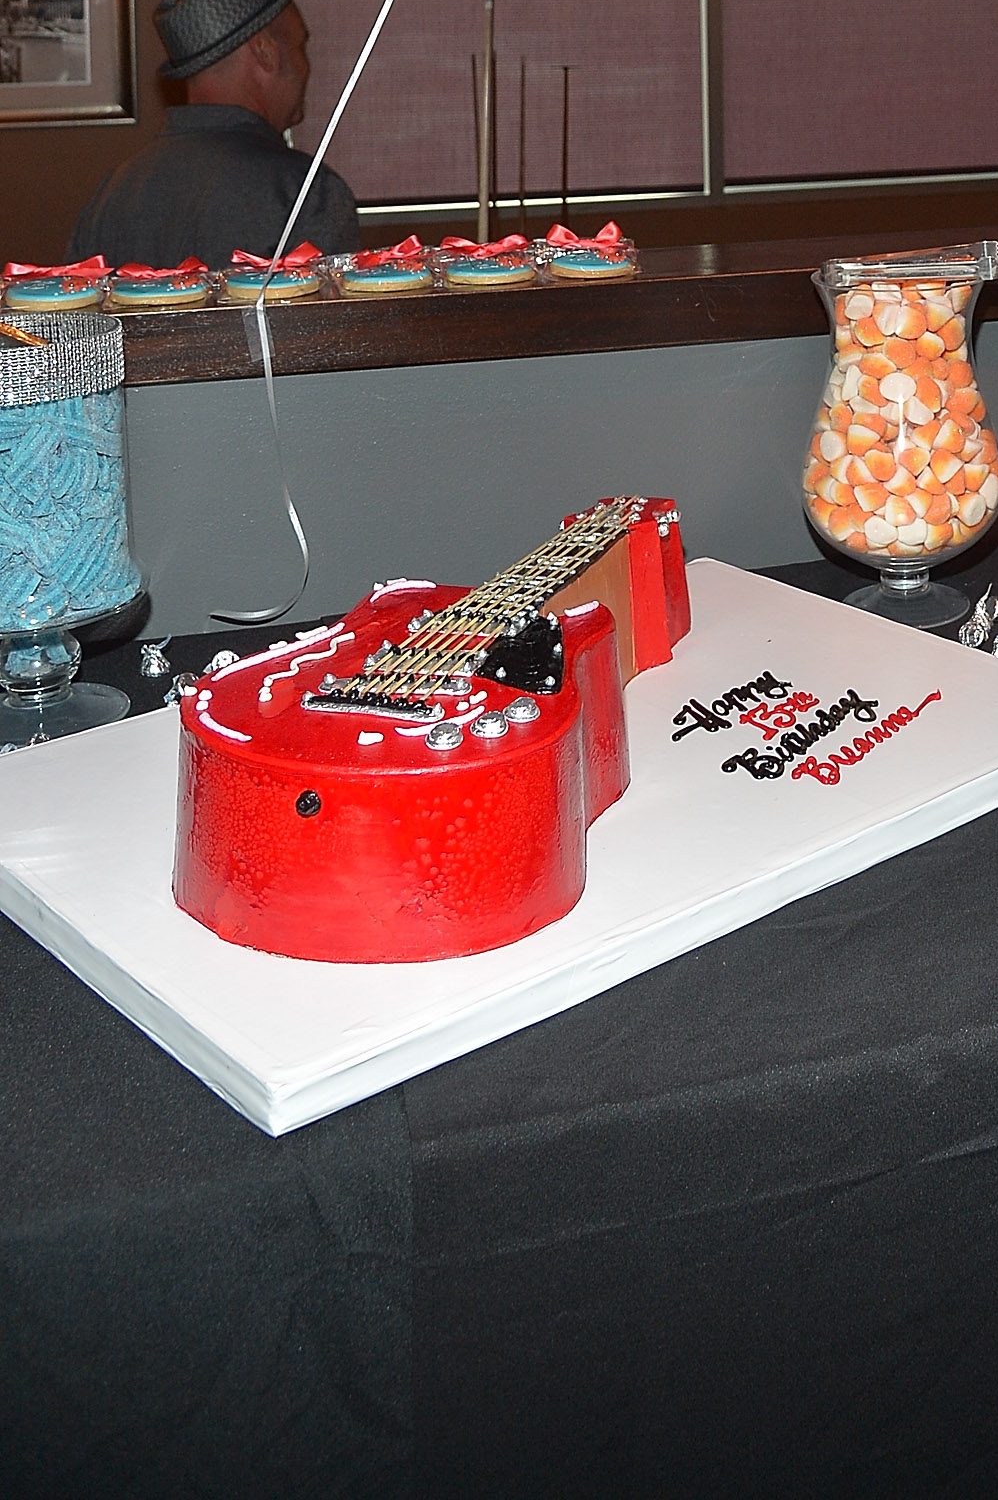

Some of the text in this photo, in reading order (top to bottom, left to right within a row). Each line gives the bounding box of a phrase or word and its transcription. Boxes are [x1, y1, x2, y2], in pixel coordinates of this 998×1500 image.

[671, 670, 793, 742] Happy
[721, 688, 879, 780] Birthday
[791, 688, 942, 786] Breanna
